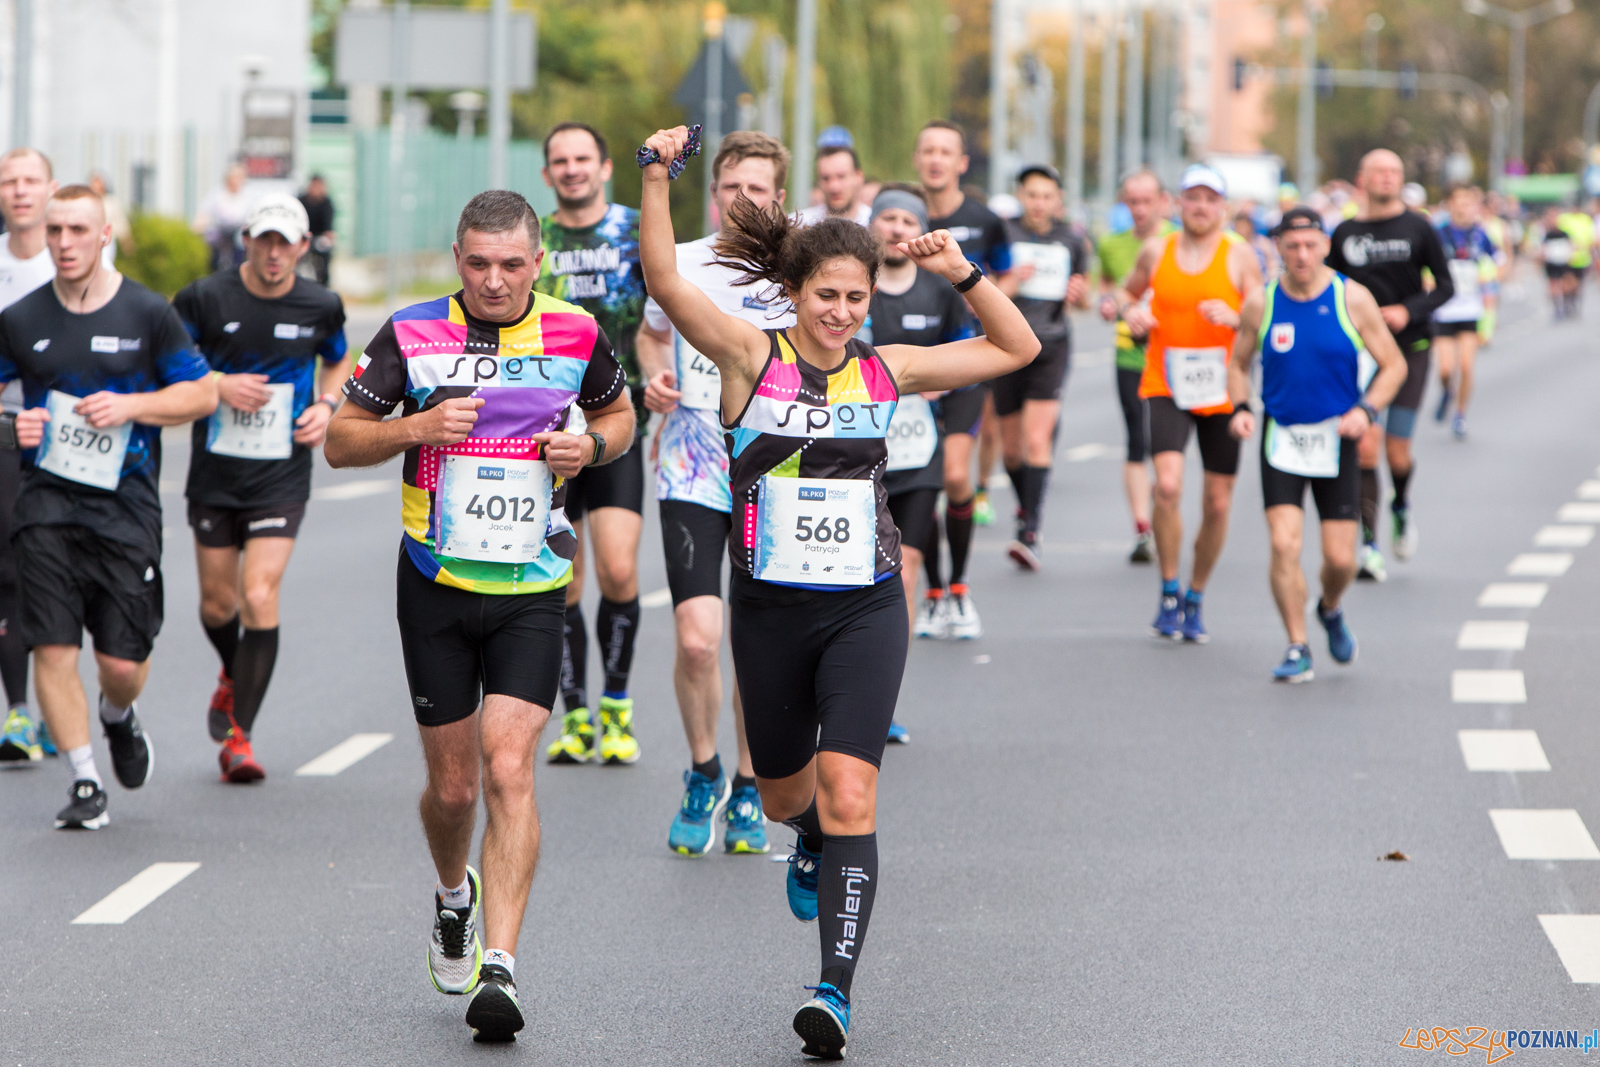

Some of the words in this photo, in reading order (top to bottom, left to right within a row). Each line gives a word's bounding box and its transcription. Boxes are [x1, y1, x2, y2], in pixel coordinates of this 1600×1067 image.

[58, 423, 113, 455] 5570
[480, 469, 488, 477] 18.
[465, 494, 536, 522] 4012
[488, 523, 514, 532] Jacek
[795, 515, 850, 544] 568
[804, 544, 840, 554] Patrycja
